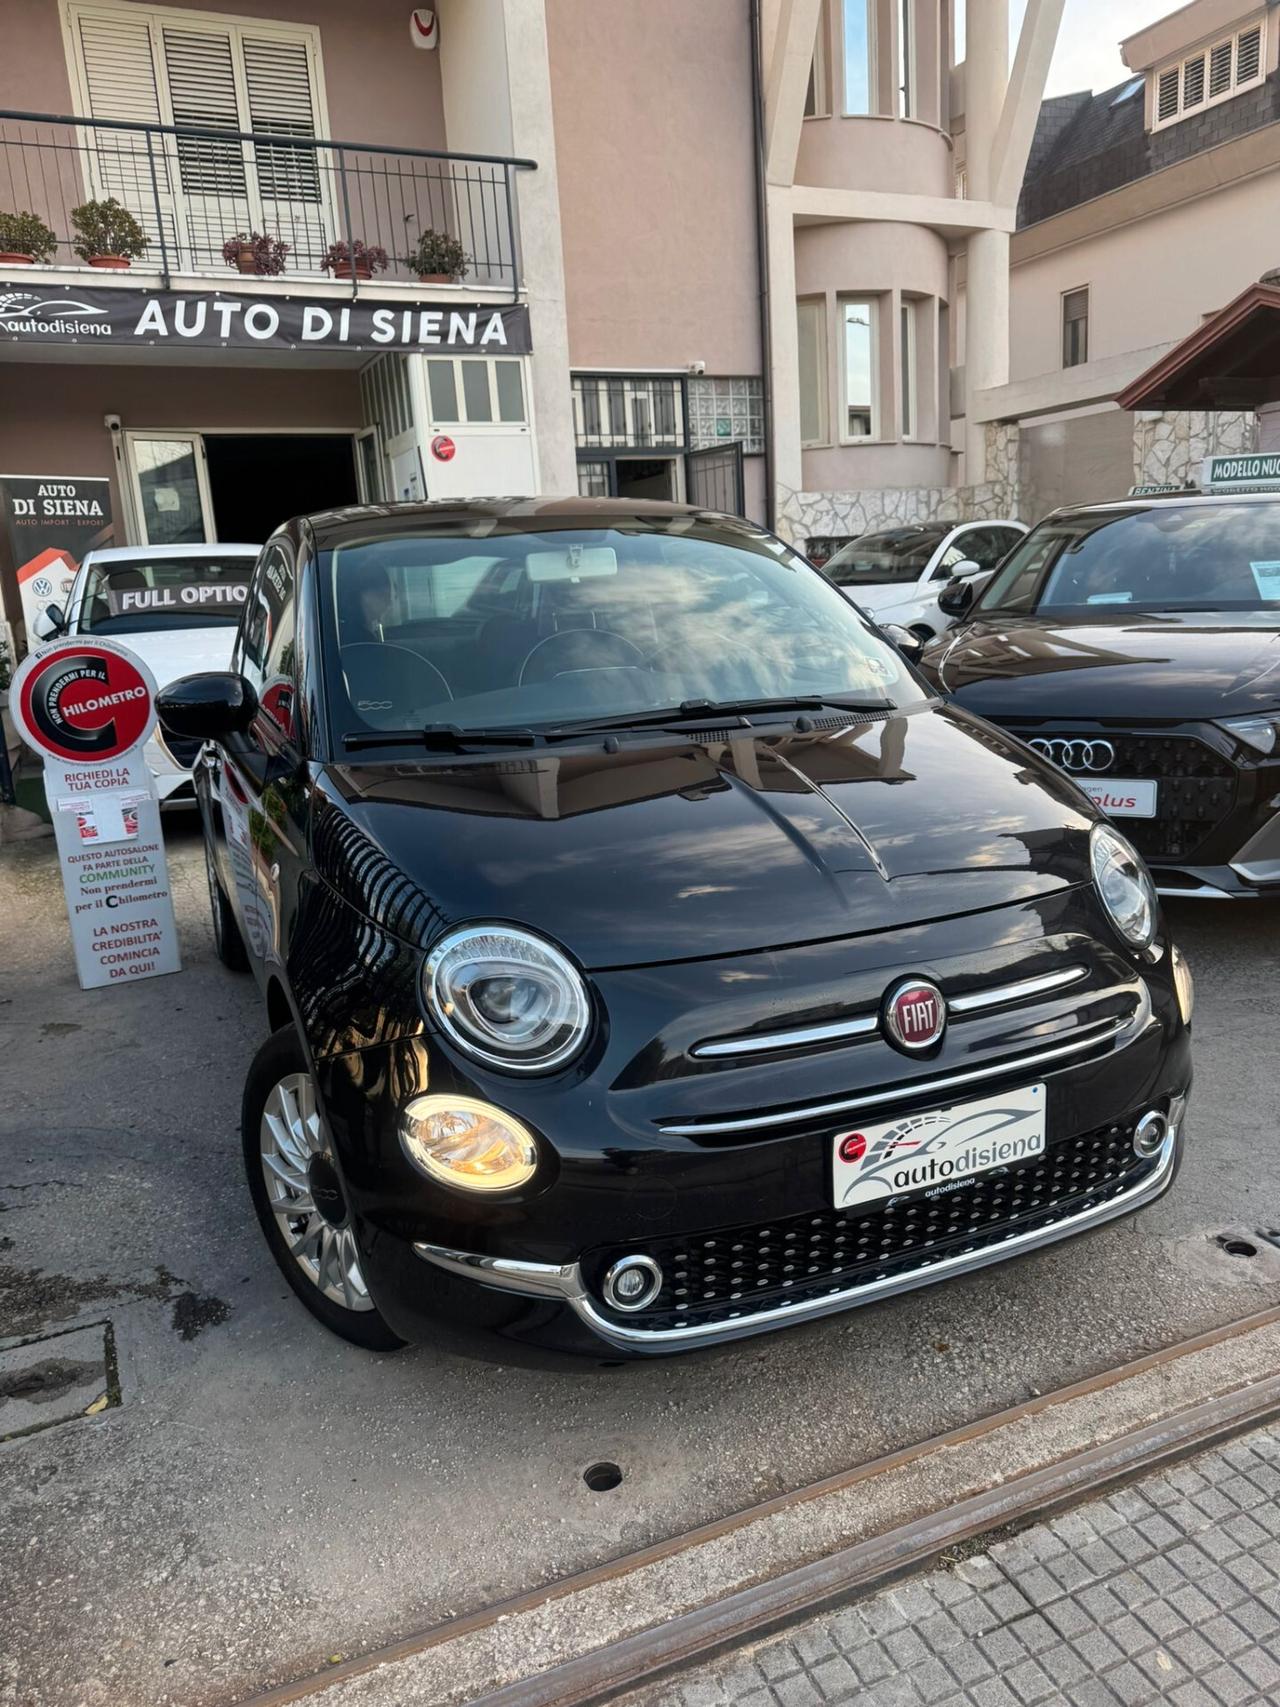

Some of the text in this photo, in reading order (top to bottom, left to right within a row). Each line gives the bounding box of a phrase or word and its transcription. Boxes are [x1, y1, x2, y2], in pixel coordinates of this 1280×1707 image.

[8, 318, 112, 336] autodisiena
[133, 299, 508, 345] AUTO DI SIENA
[1213, 459, 1260, 479] MODELLO
[37, 484, 76, 497] AUTO
[12, 498, 104, 516] DI SIENA
[15, 518, 38, 526] AUTO
[41, 518, 70, 526] IMPORT
[122, 588, 177, 610] FULL
[48, 669, 107, 725] NON PRENDERMI PER IL
[64, 767, 130, 783] RICHIEDI LA
[68, 777, 129, 791] TUA COPIA
[67, 843, 160, 864] QUESTO AUTOSALONE
[82, 855, 149, 872] FA PARTE DELLA
[79, 863, 155, 884] COMMUNITY
[80, 876, 158, 896] Non prendermi
[75, 890, 168, 914] per il Chilometro
[93, 918, 159, 937] LA NOSTRA
[100, 946, 161, 965] COMINCIA
[109, 961, 155, 978] DA QUI!
[902, 999, 934, 1034] FIAT
[893, 1133, 1041, 1188] autodisiena
[924, 1177, 976, 1198] autodisiena
